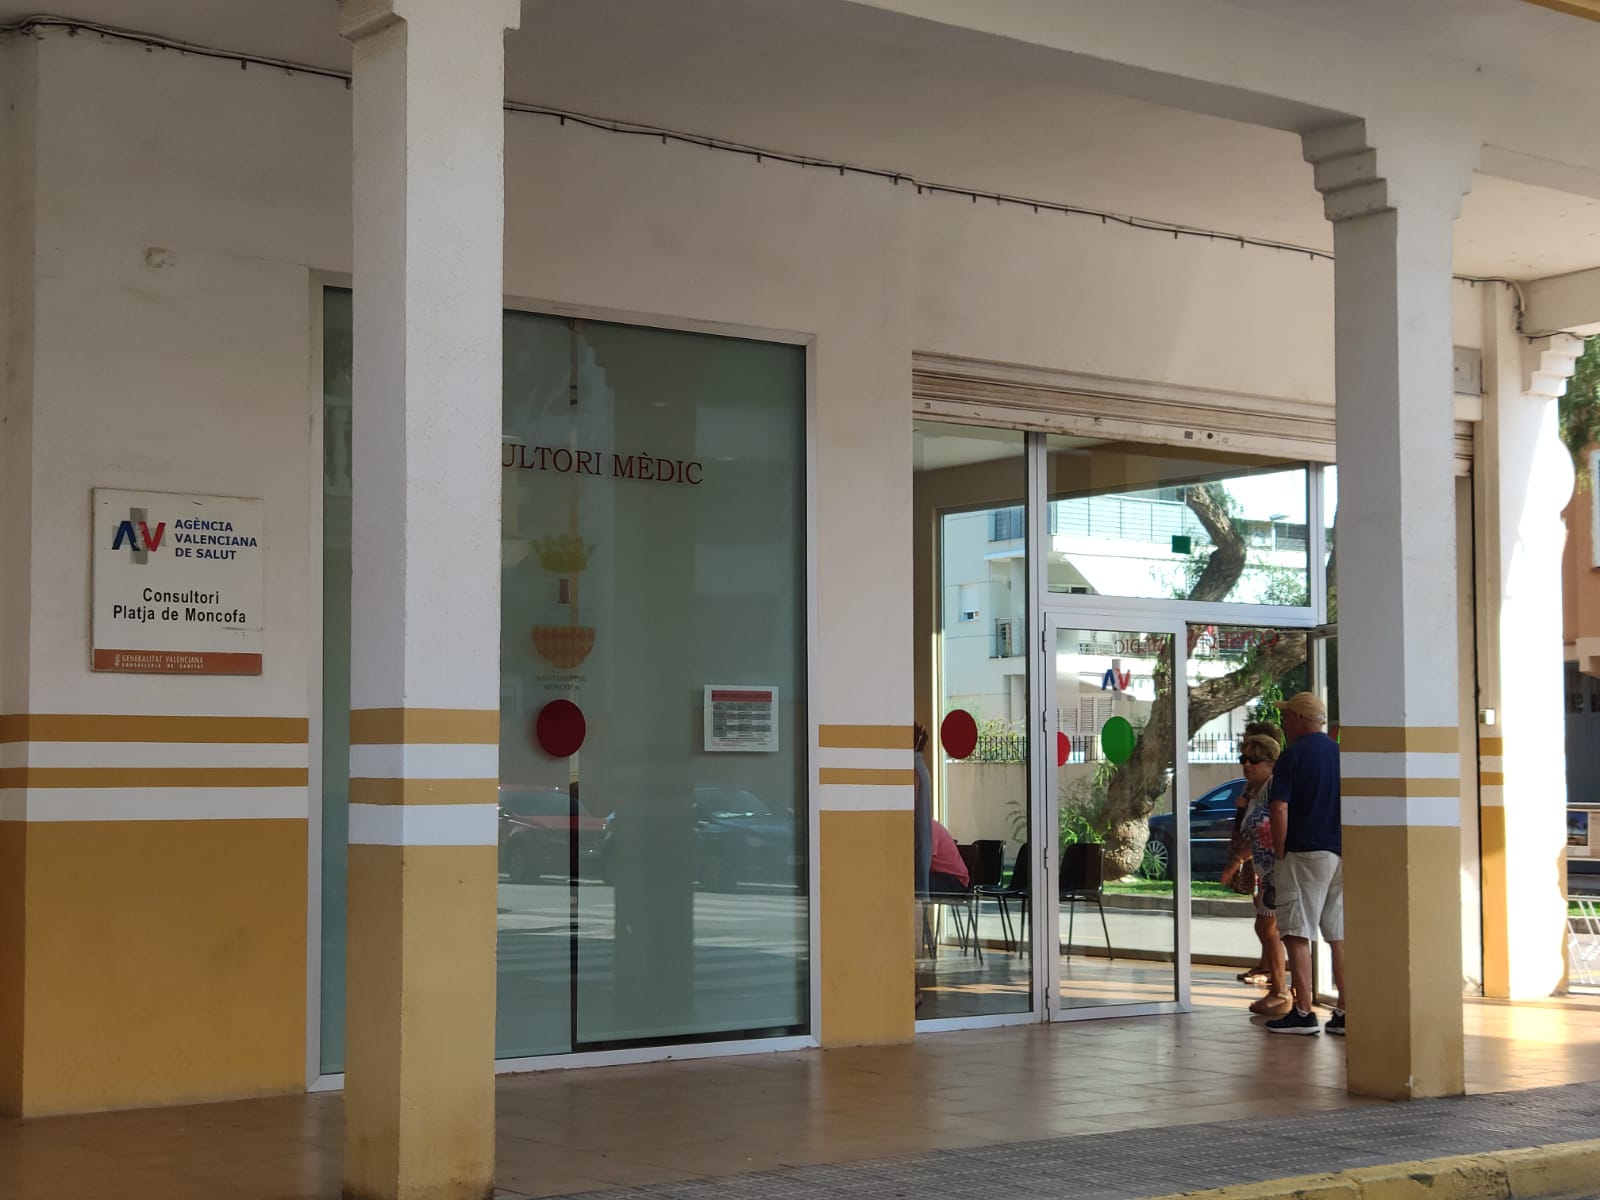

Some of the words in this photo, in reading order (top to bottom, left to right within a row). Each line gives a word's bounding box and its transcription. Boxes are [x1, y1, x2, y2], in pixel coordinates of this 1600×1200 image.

[612, 452, 703, 485] MÈDIC
[175, 517, 233, 532] AGÈNCIA
[175, 533, 258, 548] VALENCIANA
[175, 547, 192, 558] DE
[196, 549, 237, 560] SALUT
[143, 587, 219, 604] Consultori
[113, 605, 155, 623] Platja
[162, 607, 179, 621] de
[185, 607, 246, 623] Moncofa
[122, 655, 162, 664] GENERALITAT
